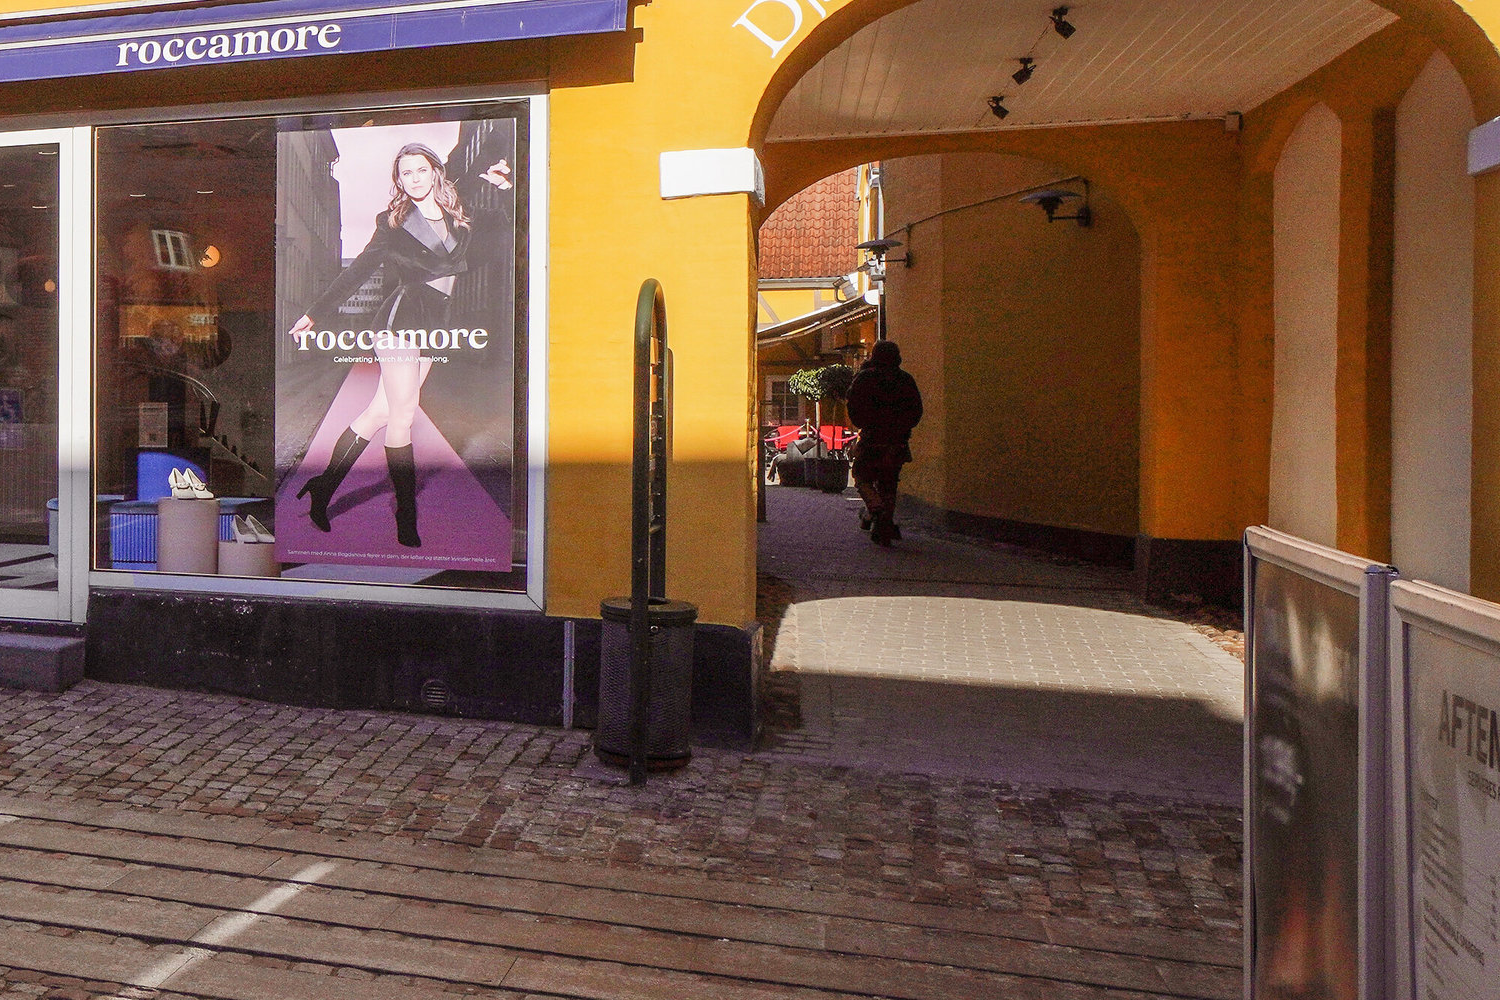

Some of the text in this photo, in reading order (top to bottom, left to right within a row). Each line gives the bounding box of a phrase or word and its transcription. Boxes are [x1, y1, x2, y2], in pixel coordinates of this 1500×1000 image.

[116, 23, 342, 67] roccamore
[297, 327, 489, 351] roccamore
[334, 356, 373, 364] Celebrating
[432, 356, 450, 364] long.
